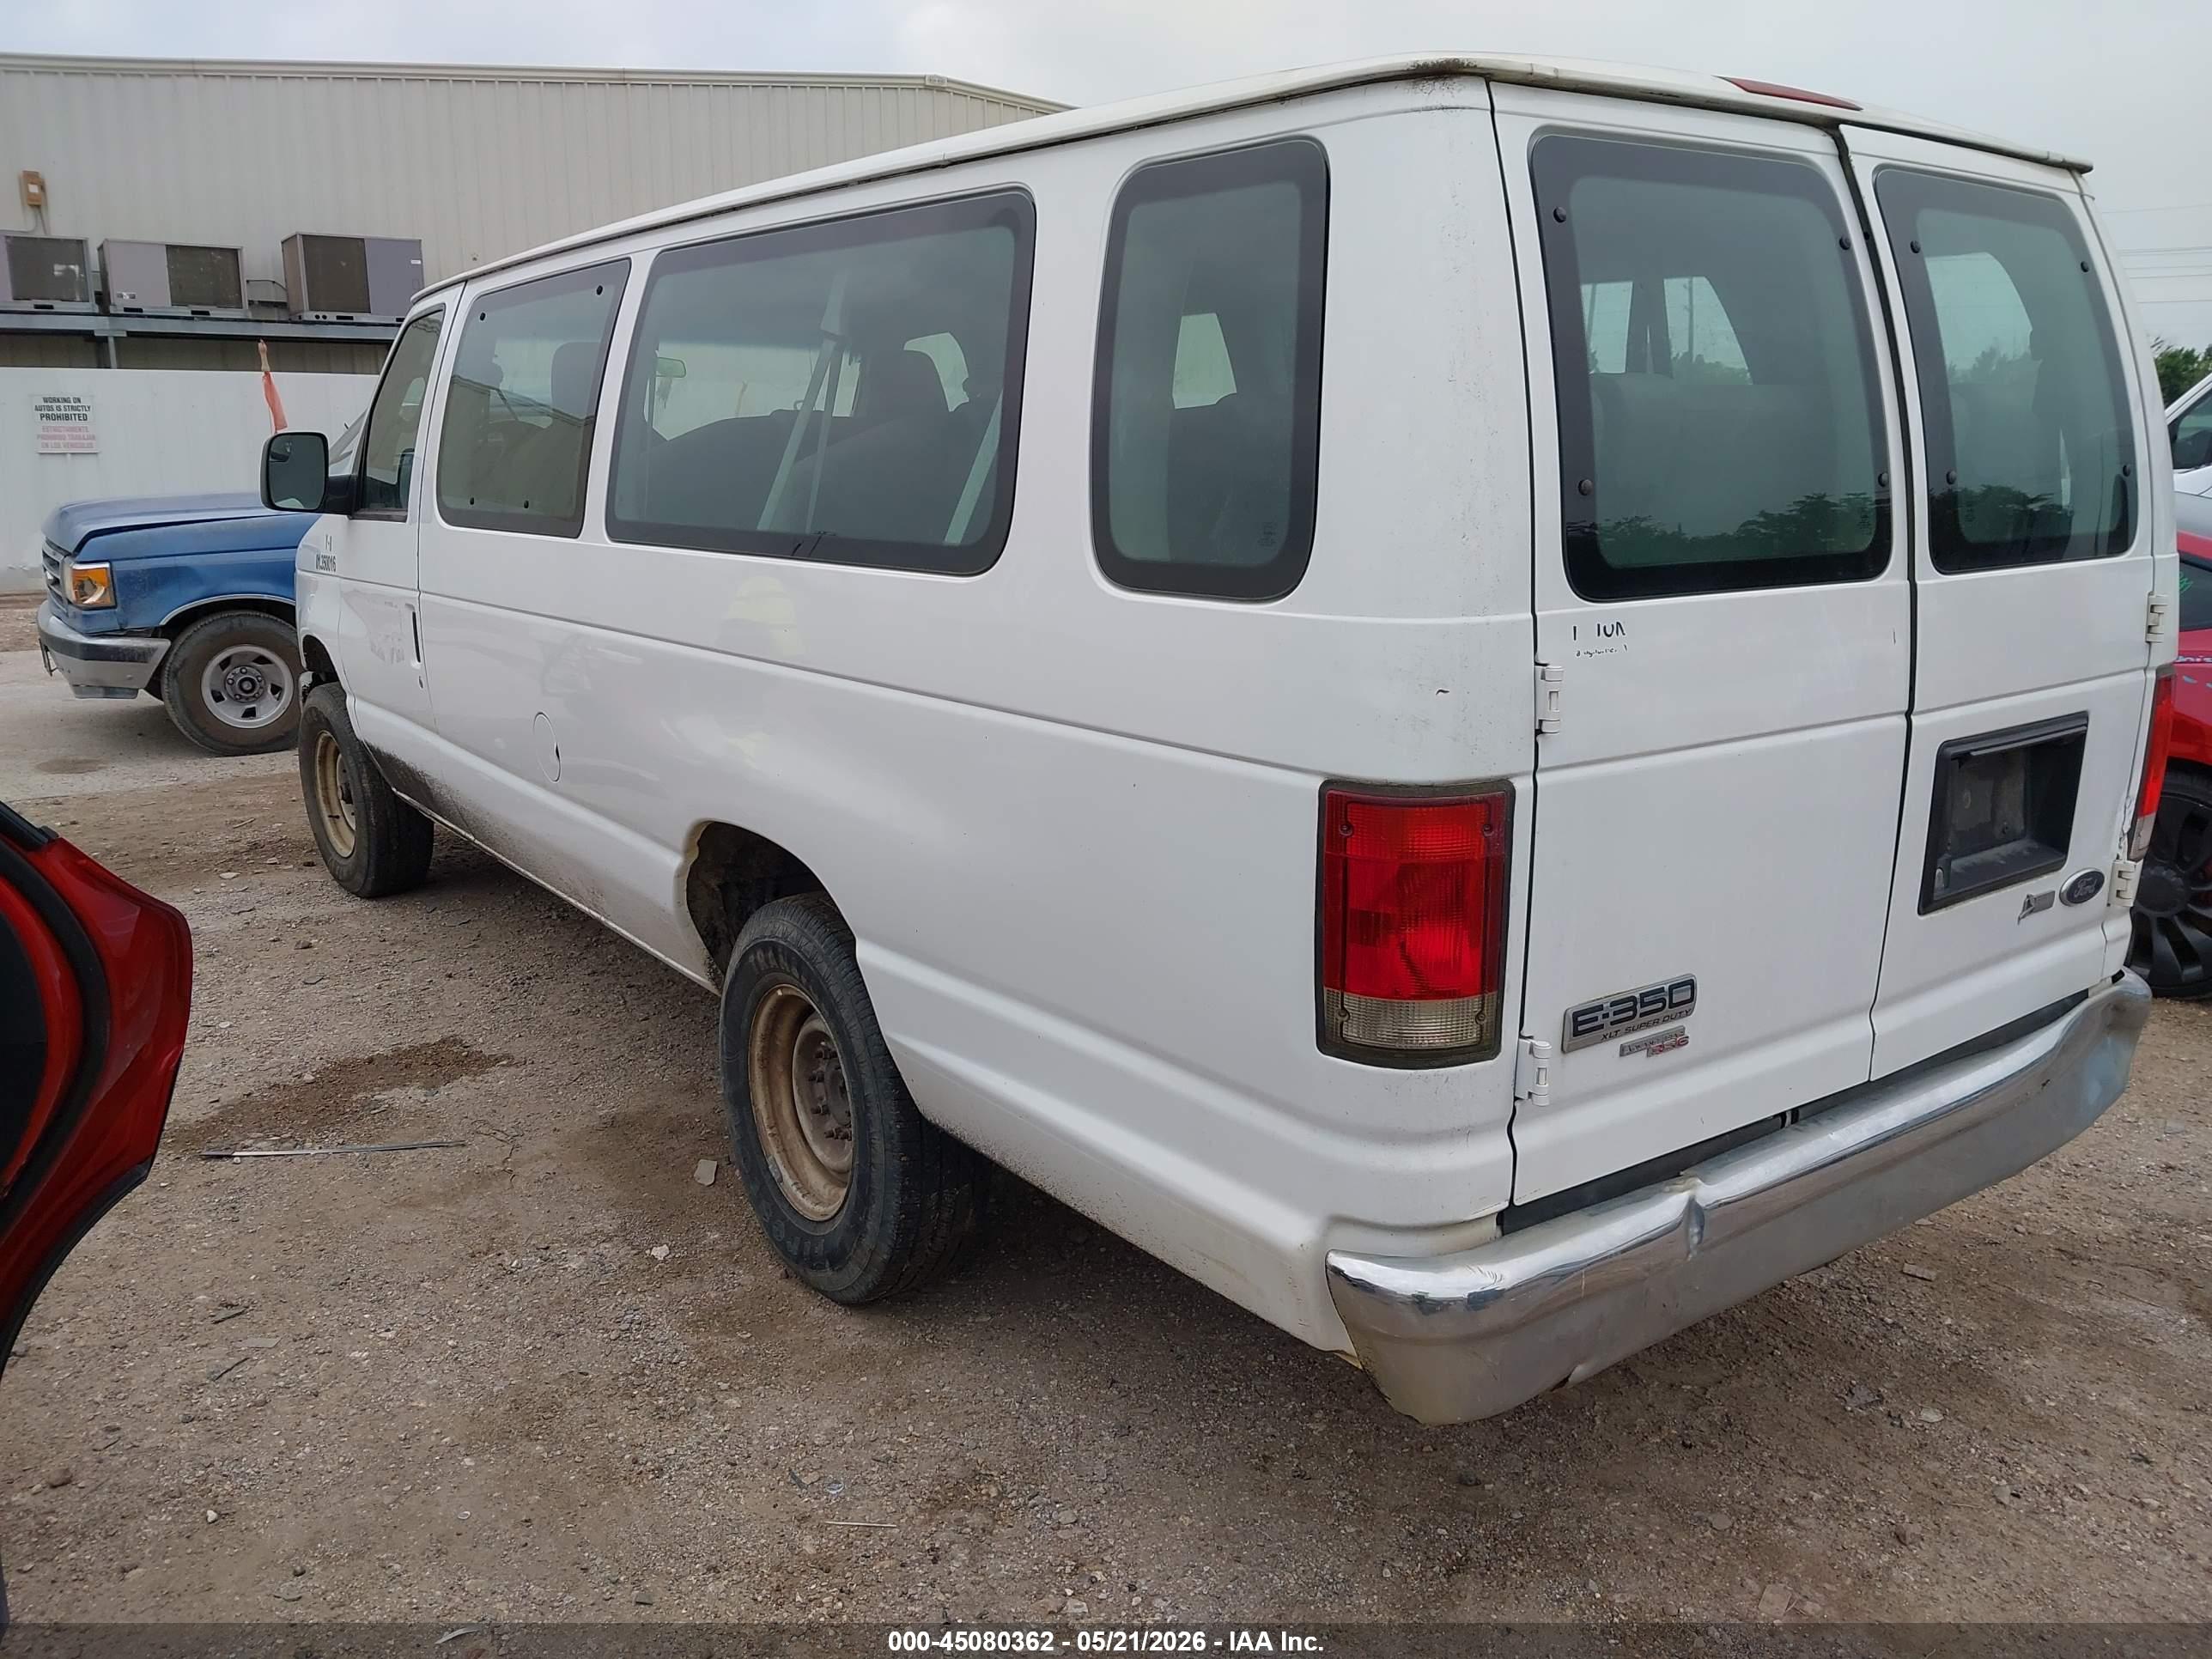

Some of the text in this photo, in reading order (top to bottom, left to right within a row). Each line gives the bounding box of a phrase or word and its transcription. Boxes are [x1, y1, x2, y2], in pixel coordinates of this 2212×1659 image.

[1601, 1030, 1620, 1041] XLT
[1624, 1016, 1660, 1033] SUPER
[1662, 1008, 1692, 1023] DUTY
